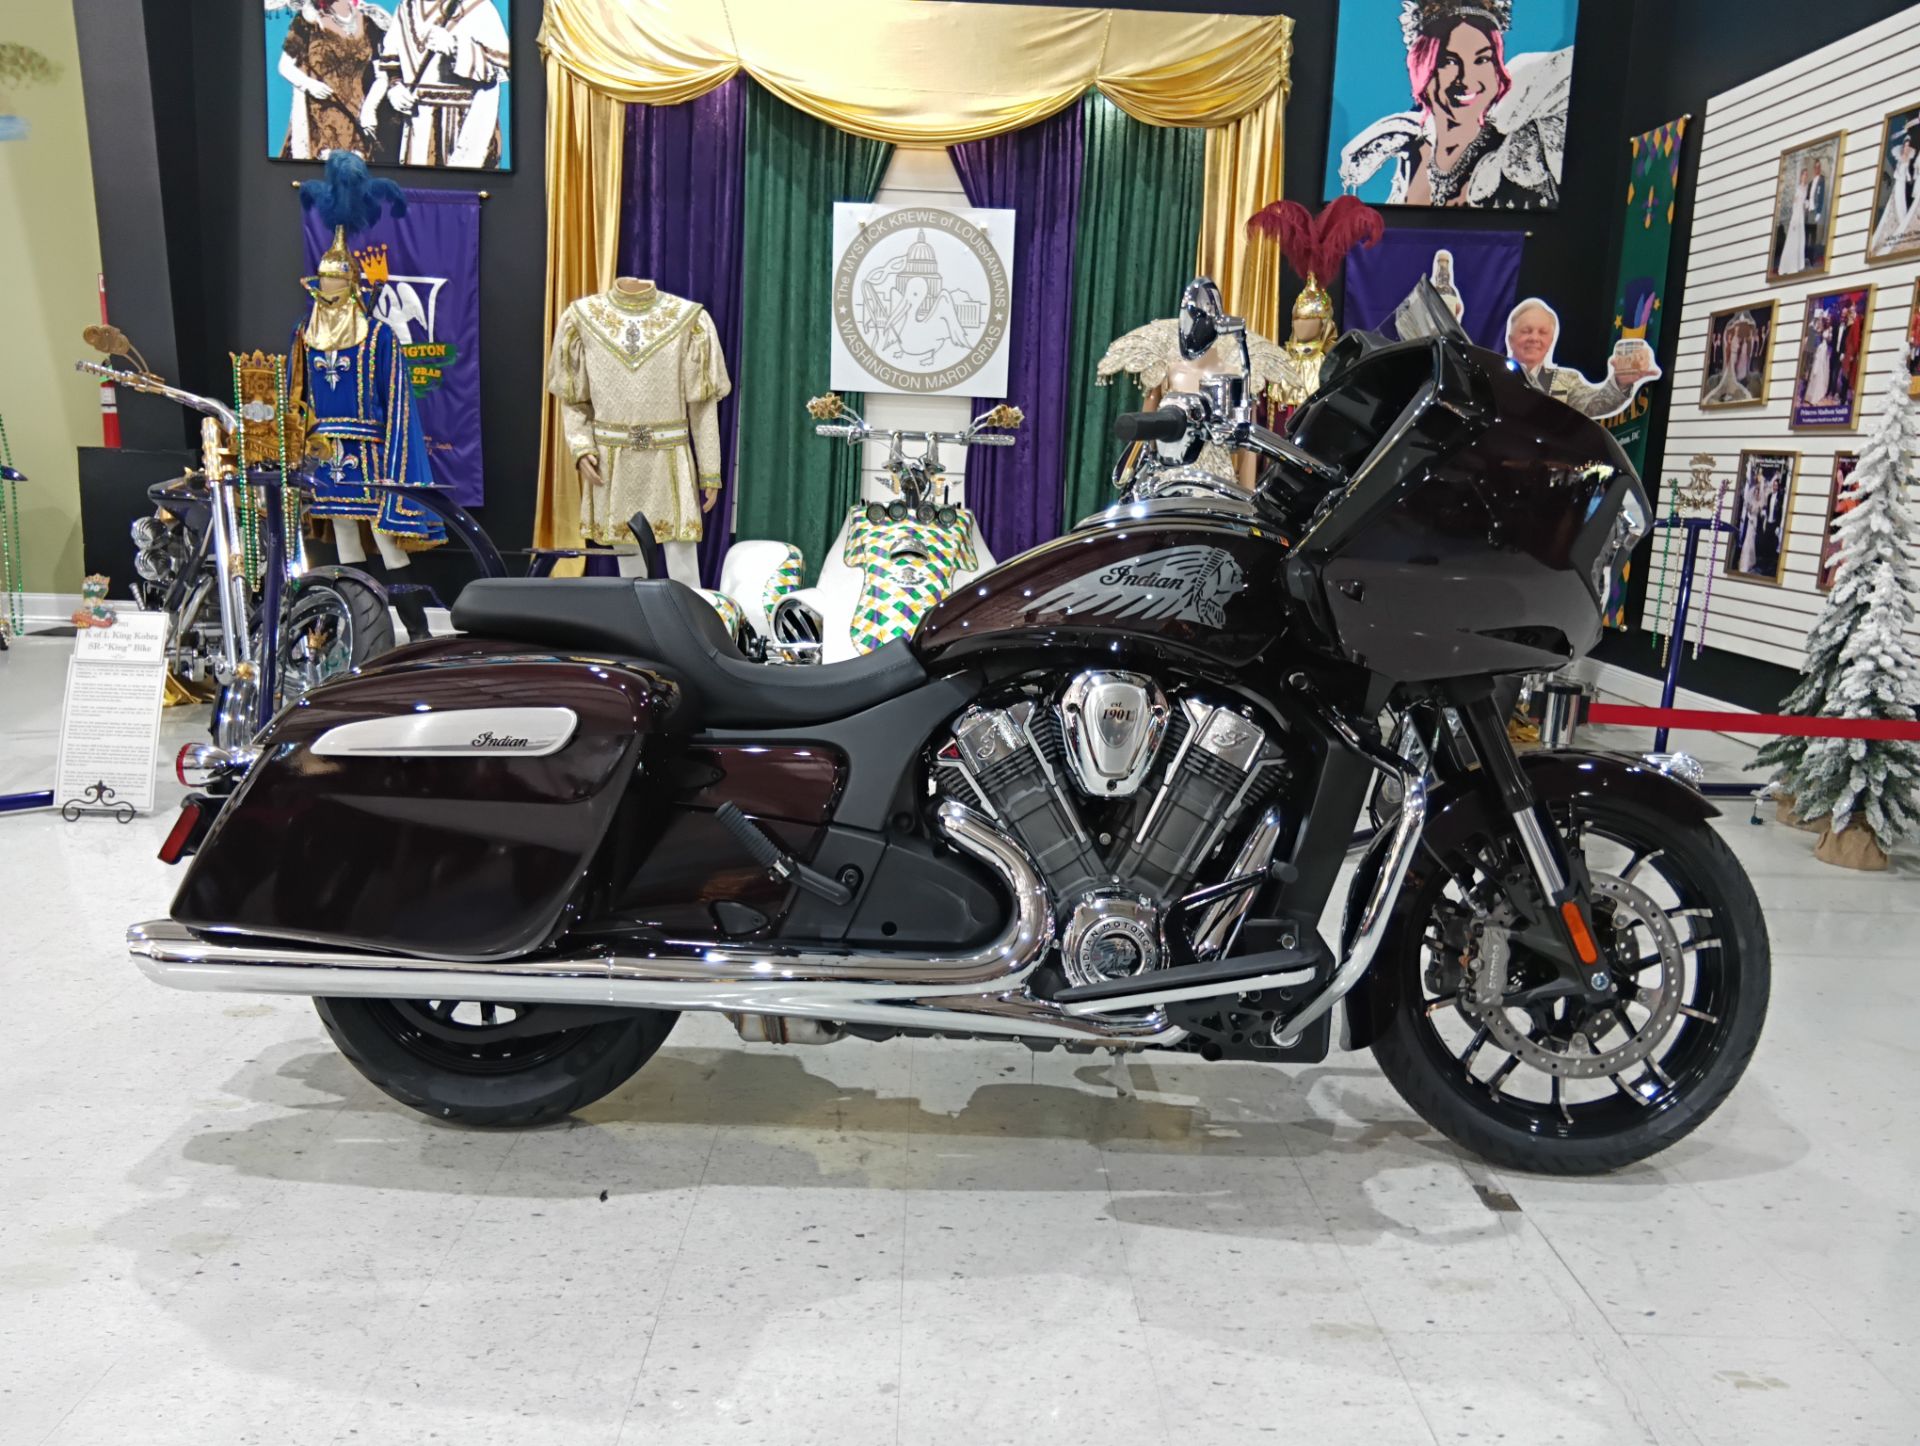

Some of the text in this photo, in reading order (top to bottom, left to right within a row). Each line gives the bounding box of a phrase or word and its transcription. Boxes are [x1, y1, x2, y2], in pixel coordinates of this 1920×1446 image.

[837, 211, 1007, 308] The MYSTICK KREWE of LOUISIANIANS
[840, 319, 1001, 389] WASHINGTON MARDI GRAS
[1099, 564, 1185, 590] Indian
[112, 631, 132, 640] King
[134, 631, 159, 641] Kobra
[134, 643, 152, 652] Bike
[1103, 708, 1132, 721] 1901
[471, 730, 529, 748] Indian
[1102, 920, 1153, 973] MOTORCYC
[1486, 944, 1500, 989] brembo
